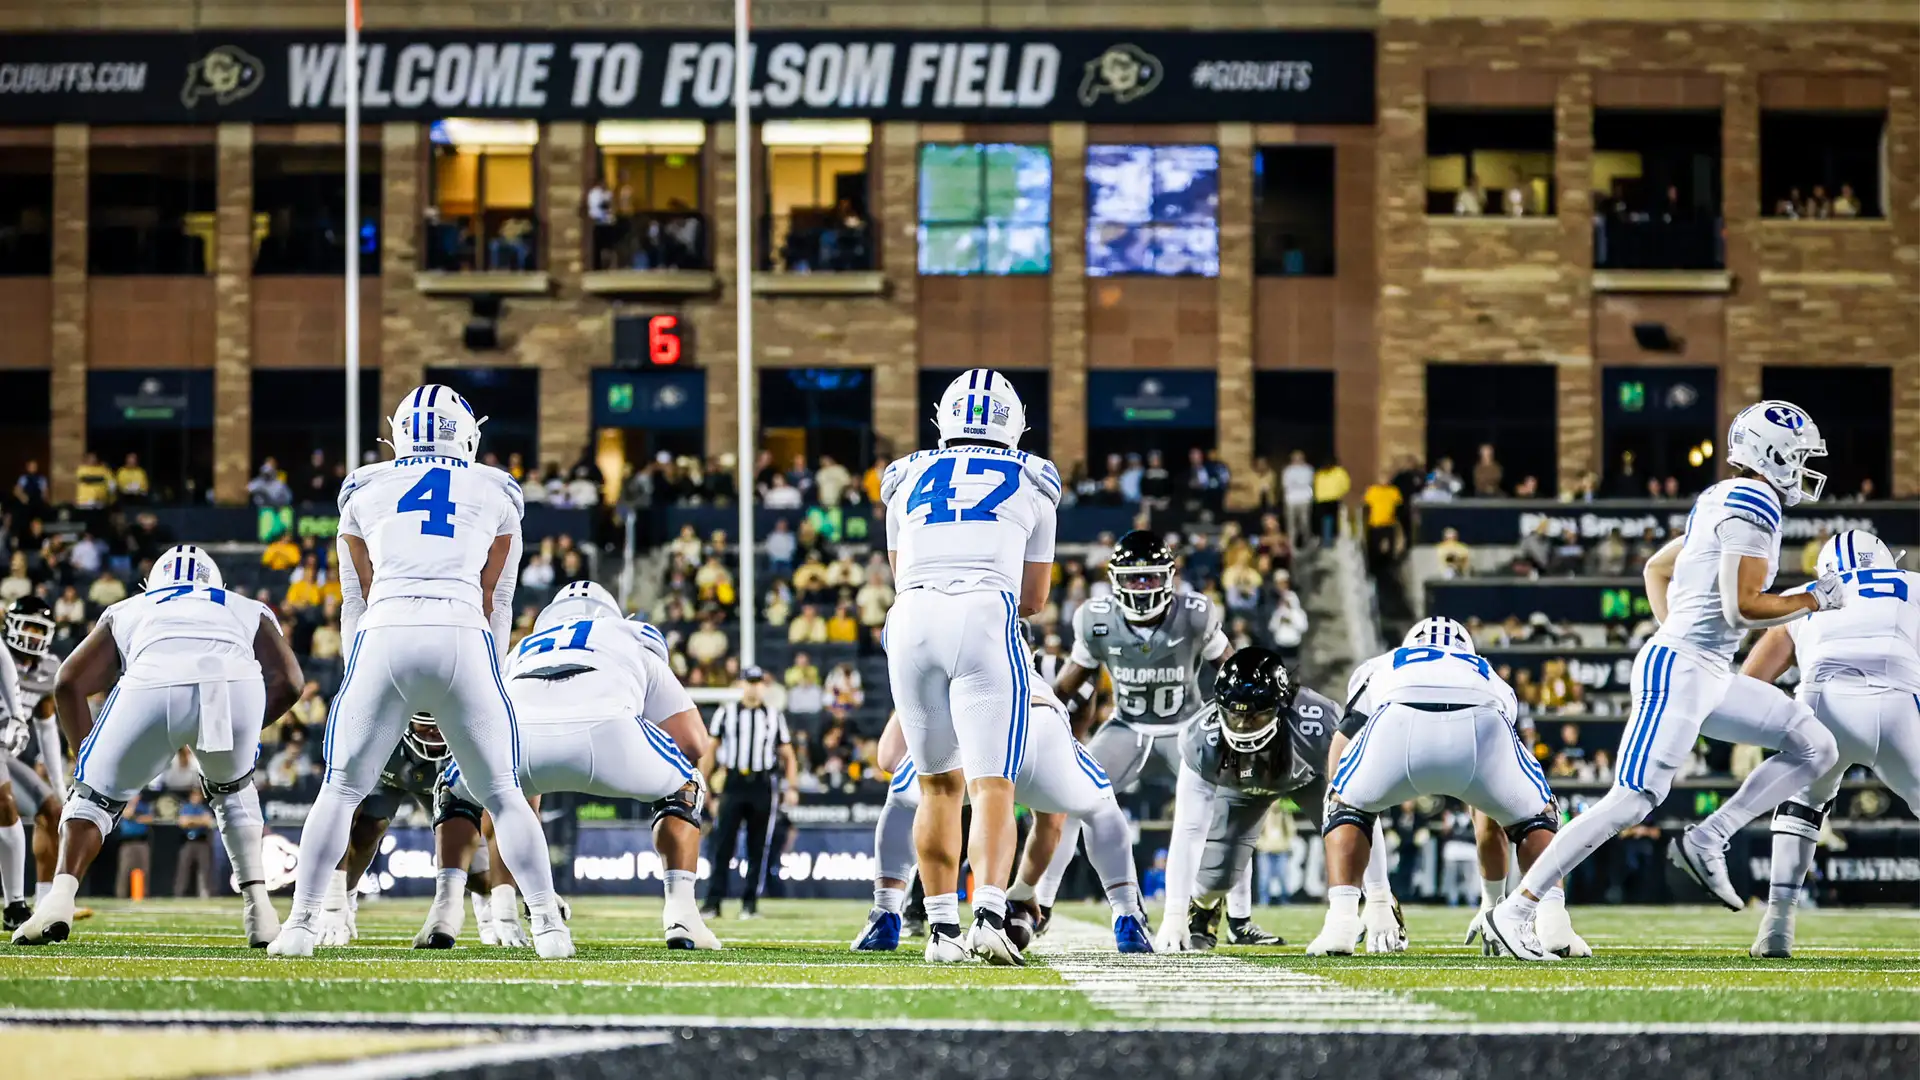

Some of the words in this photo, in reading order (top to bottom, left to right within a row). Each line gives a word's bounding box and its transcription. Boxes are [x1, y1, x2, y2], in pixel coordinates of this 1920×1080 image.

[288, 44, 554, 107] WELCOME
[571, 44, 642, 106] TO
[661, 43, 893, 107] FOLSOM
[902, 43, 1060, 107] FIELD
[1192, 60, 1312, 91] #GOBUFFS
[648, 314, 681, 365] 6
[394, 456, 469, 468] MARTIN
[397, 467, 456, 538] 4
[906, 457, 1024, 525] 47
[518, 620, 595, 658] 51
[1113, 665, 1185, 684] COLORADO
[1118, 682, 1186, 718] 50
[1299, 704, 1324, 738] 96
